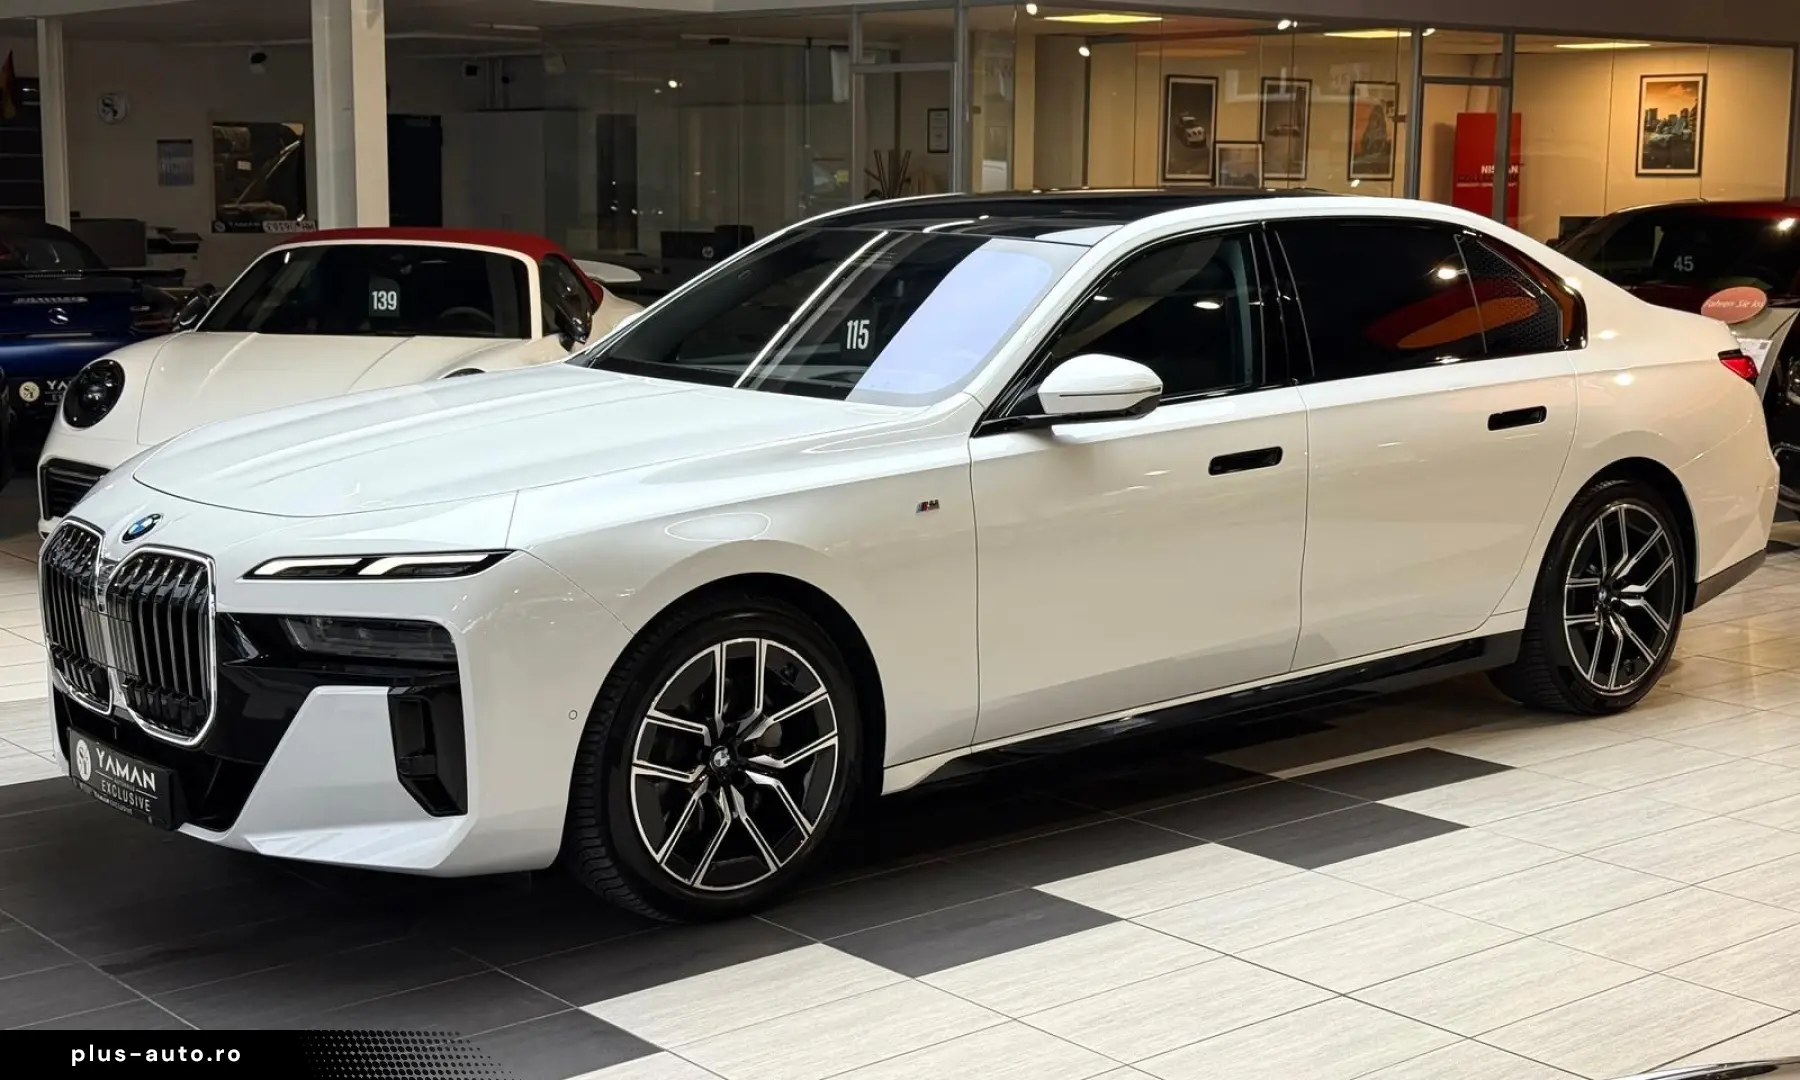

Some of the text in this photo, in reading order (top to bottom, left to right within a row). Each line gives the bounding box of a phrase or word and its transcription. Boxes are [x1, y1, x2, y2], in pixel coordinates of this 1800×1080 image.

[1673, 255, 1694, 271] 45
[372, 290, 397, 310] 139
[847, 319, 870, 350] 115
[96, 747, 156, 792] YAMAN
[101, 780, 151, 812] EXCLUSIVE
